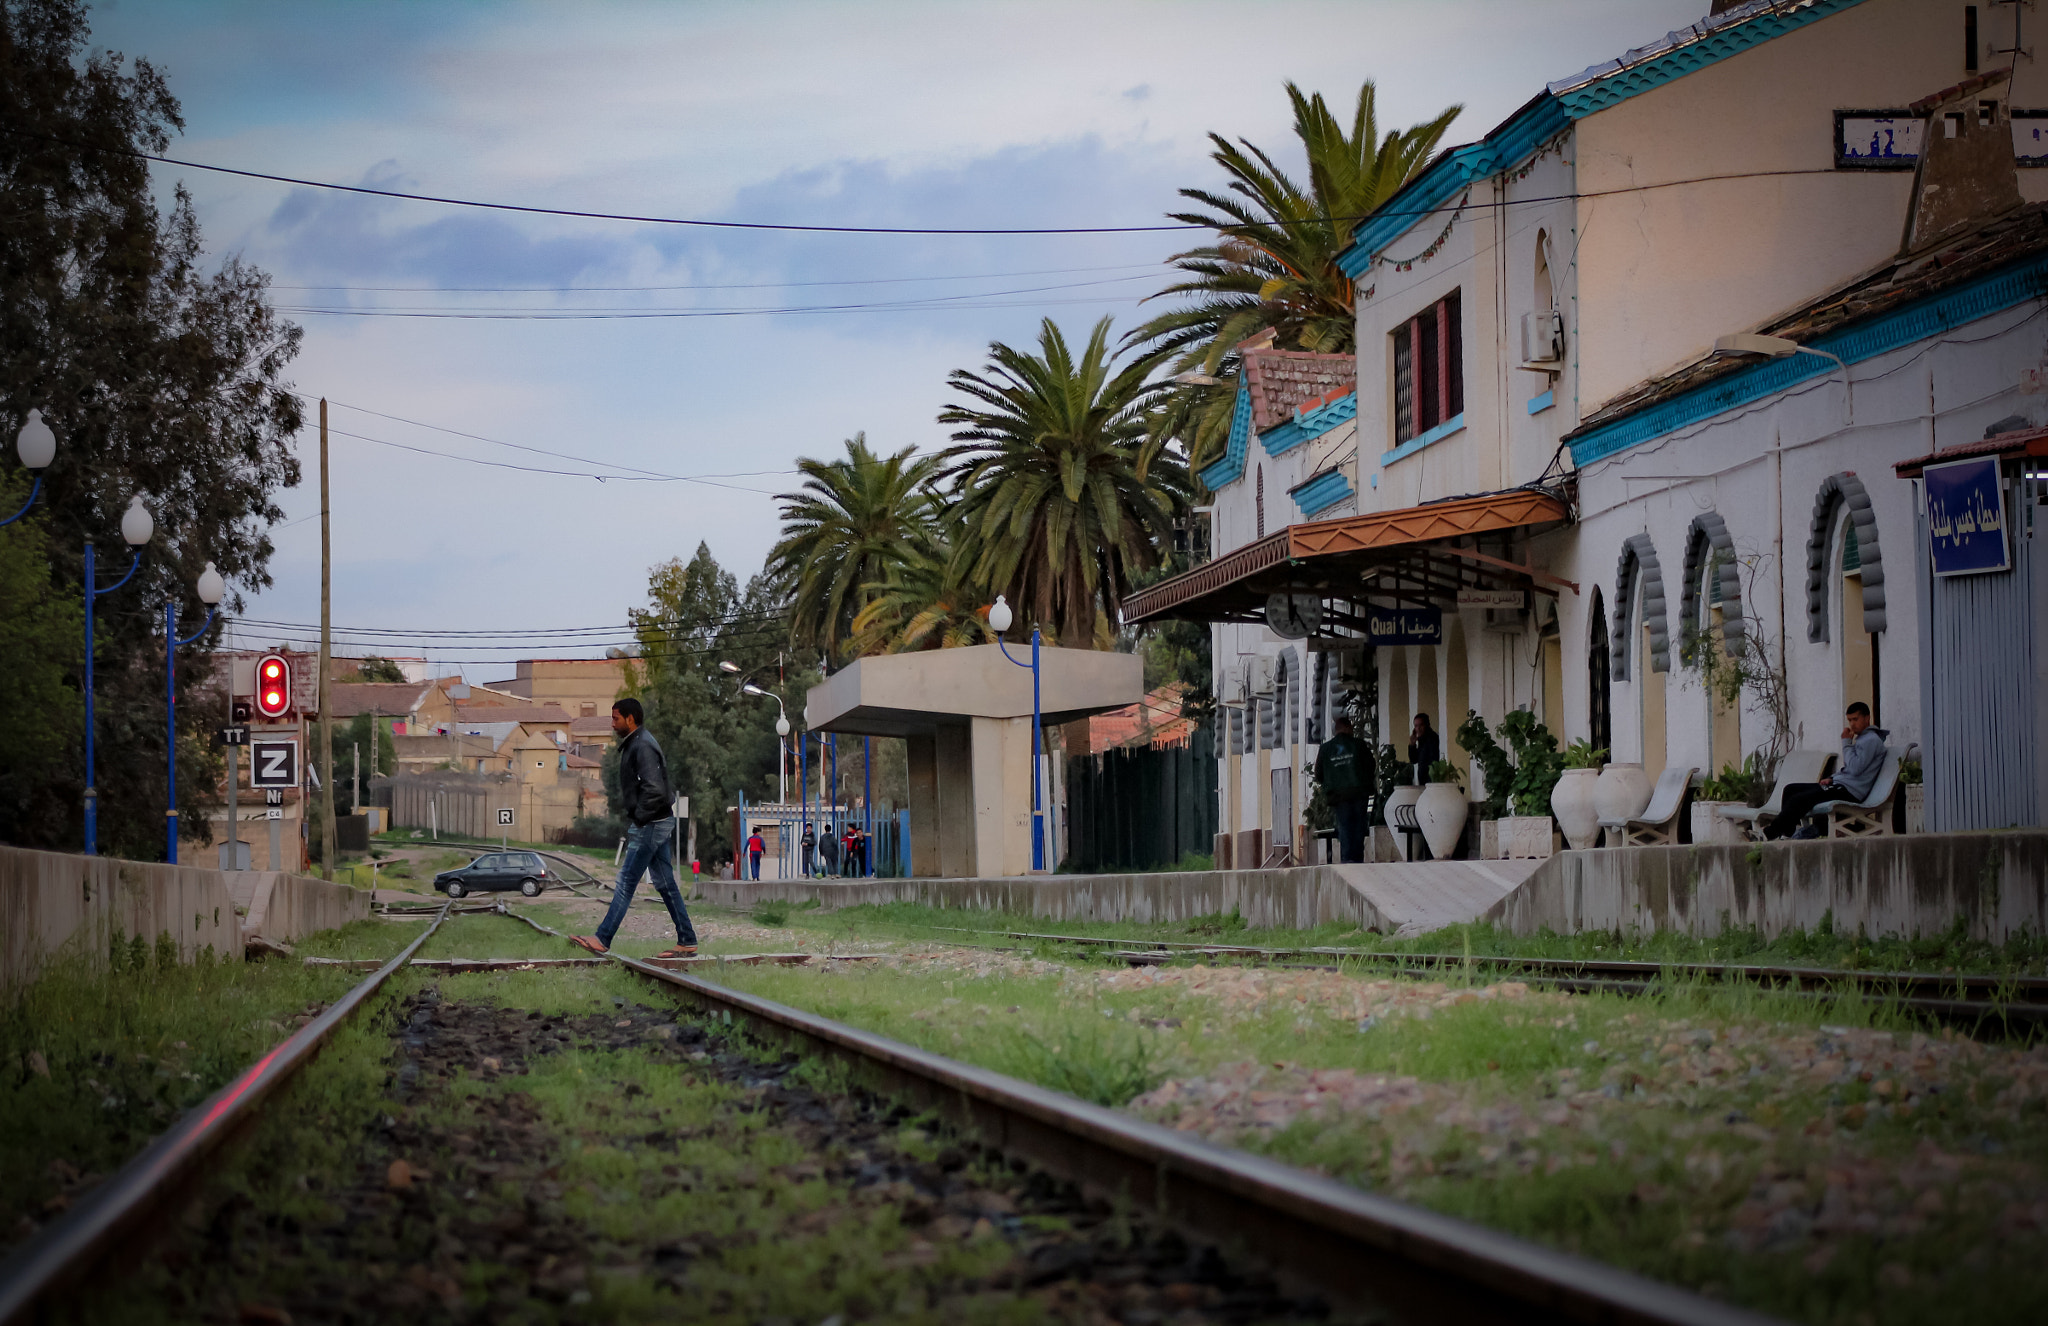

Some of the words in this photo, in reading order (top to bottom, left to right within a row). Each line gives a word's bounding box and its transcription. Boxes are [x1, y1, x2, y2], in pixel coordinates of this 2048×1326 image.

[1975, 487, 2001, 532] محطة
[1929, 493, 1952, 549] مليانة
[1952, 496, 1976, 547] خميس
[1371, 616, 1396, 636] Quai
[1399, 616, 1405, 635] 1
[1407, 617, 1440, 639] رصيف
[223, 729, 244, 743] TT
[261, 750, 288, 778] Z
[267, 790, 282, 804] Nf
[500, 811, 511, 823] R
